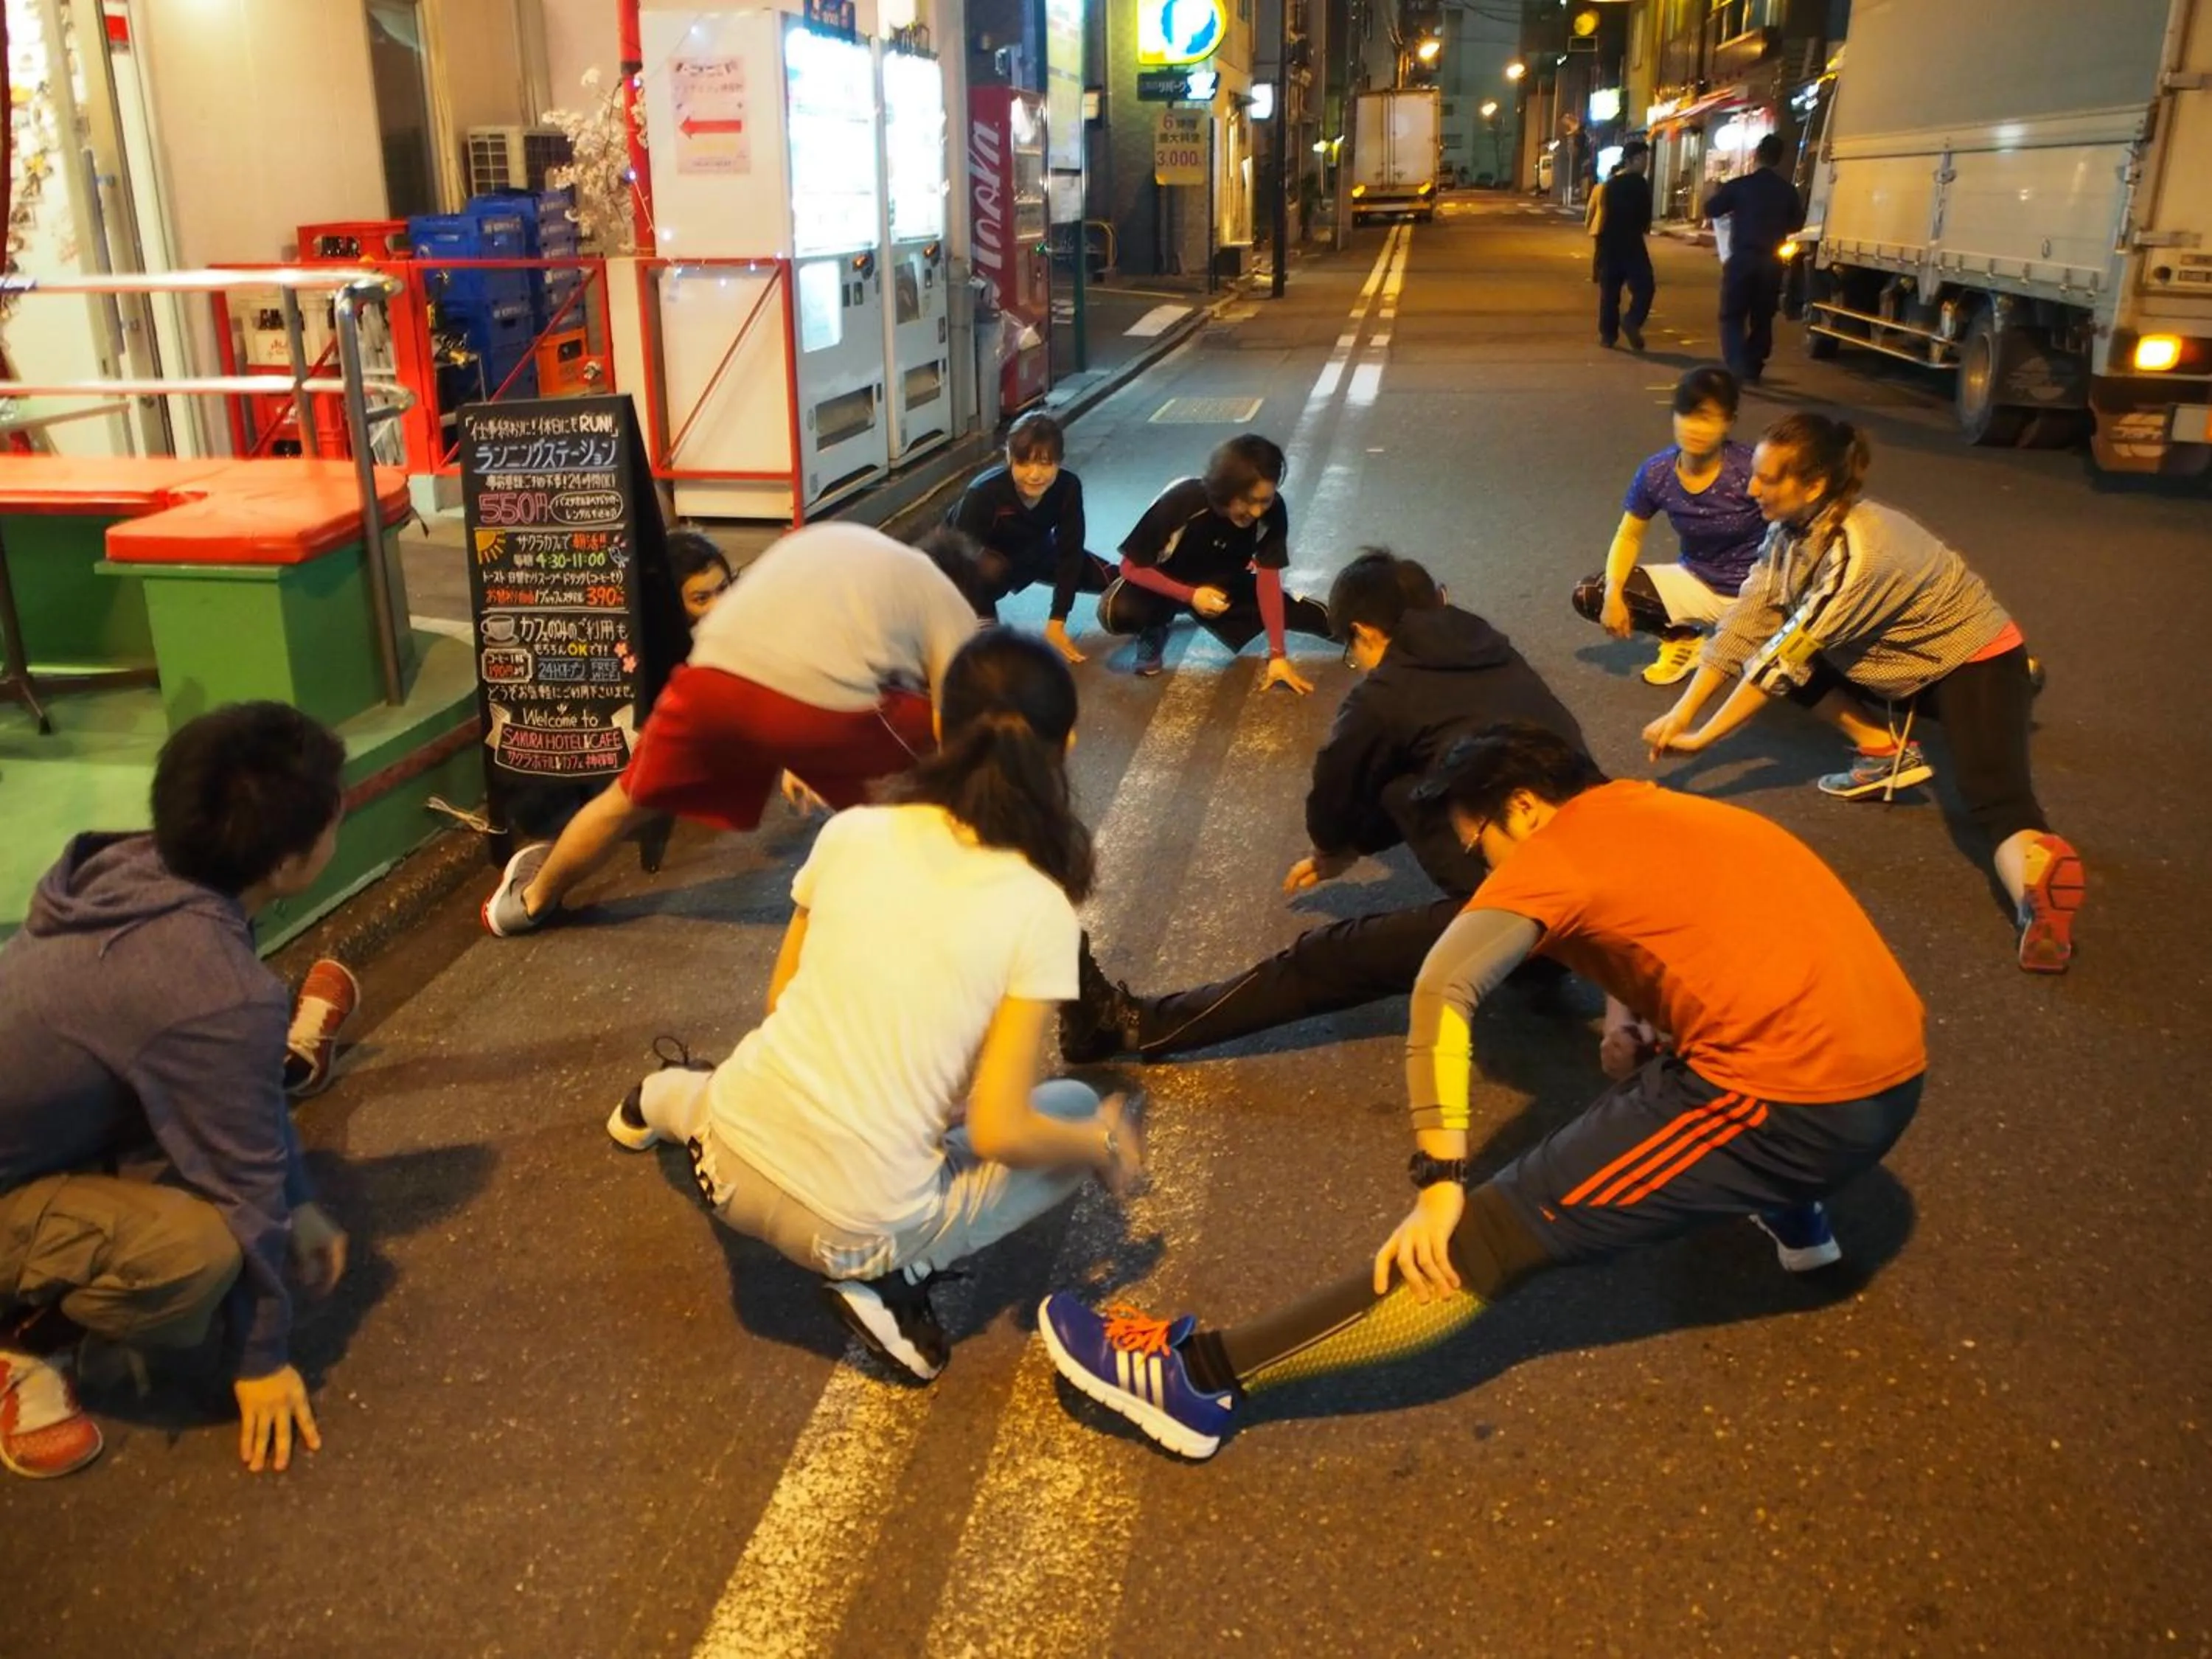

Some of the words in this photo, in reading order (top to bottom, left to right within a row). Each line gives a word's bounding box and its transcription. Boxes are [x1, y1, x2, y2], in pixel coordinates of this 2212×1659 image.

[476, 438, 616, 470] ランニングステーション
[479, 492, 548, 524] 550円
[523, 707, 577, 728] Welcome
[582, 709, 599, 728] to
[503, 728, 543, 748] SAKURA
[546, 733, 582, 750] HOTEL
[591, 730, 622, 749] CAFE
